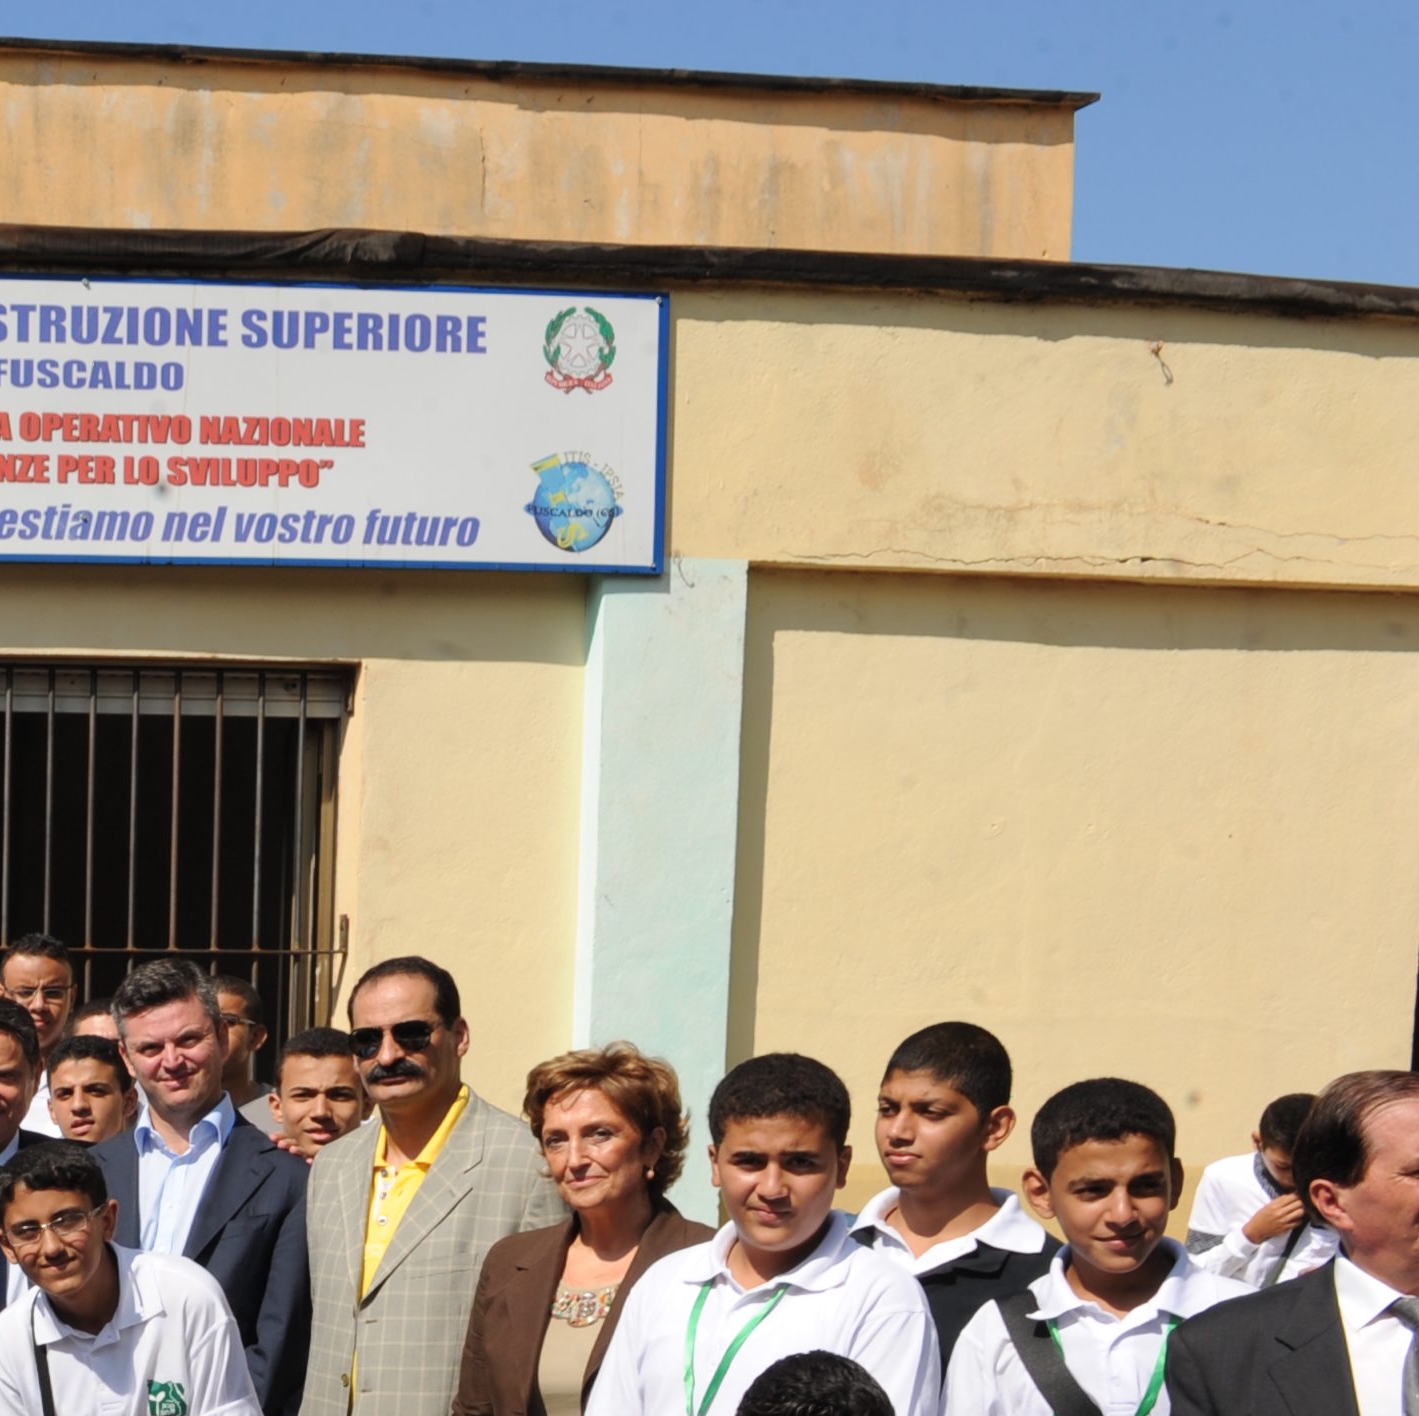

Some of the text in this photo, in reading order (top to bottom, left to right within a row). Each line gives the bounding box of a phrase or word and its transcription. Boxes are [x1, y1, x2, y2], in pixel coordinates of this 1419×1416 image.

[240, 308, 488, 354] SUPERIORE
[19, 411, 191, 444] OPERATIVO
[199, 415, 366, 448] NAZIONALE
[57, 454, 116, 485] PER
[123, 456, 160, 486] LO
[563, 450, 592, 465] ITIS
[601, 463, 625, 502] IPSIA
[162, 506, 228, 543] nel
[234, 509, 356, 545] vostro
[362, 508, 481, 548] futuro
[527, 503, 593, 518] FUSCALDO
